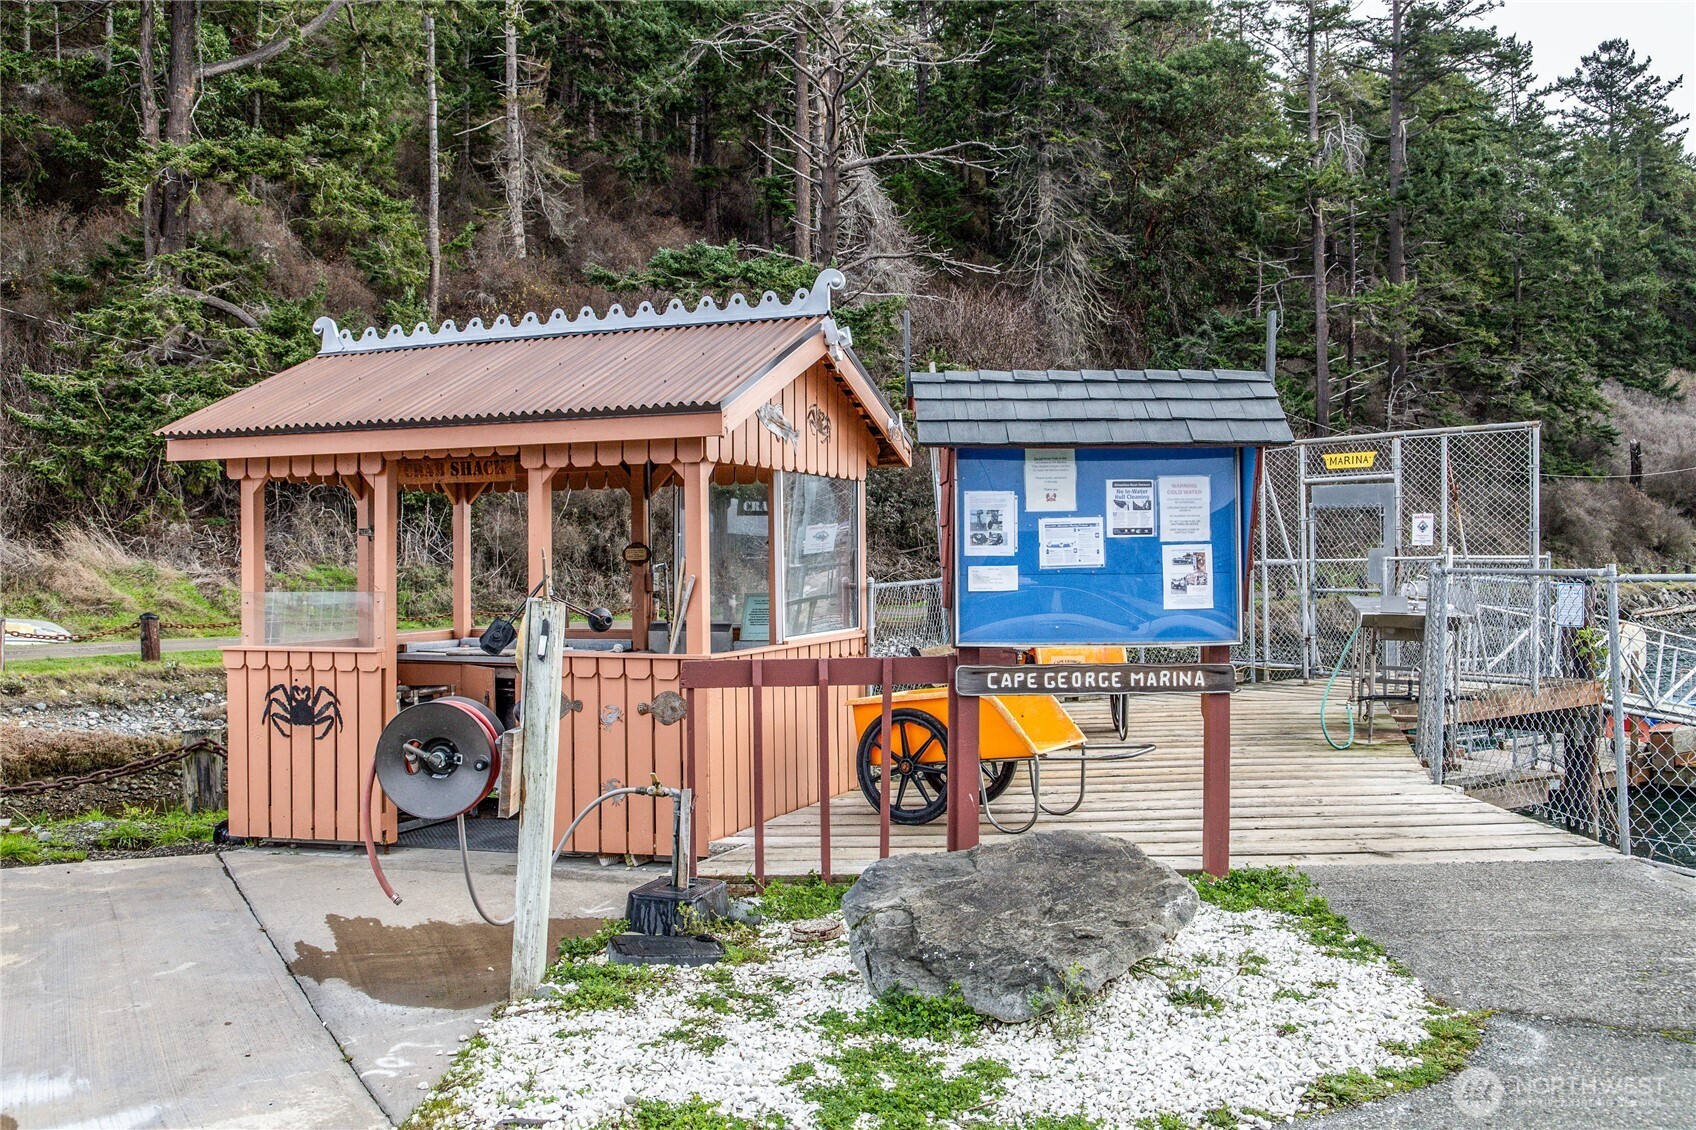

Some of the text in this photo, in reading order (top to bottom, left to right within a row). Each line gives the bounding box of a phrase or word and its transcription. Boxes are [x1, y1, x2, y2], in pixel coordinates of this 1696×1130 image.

[1329, 455, 1369, 466] MARINA
[403, 459, 508, 478] CRAB SHACK
[744, 502, 768, 512] CRA
[987, 670, 1206, 689] CAPE GEORGE MARINA
